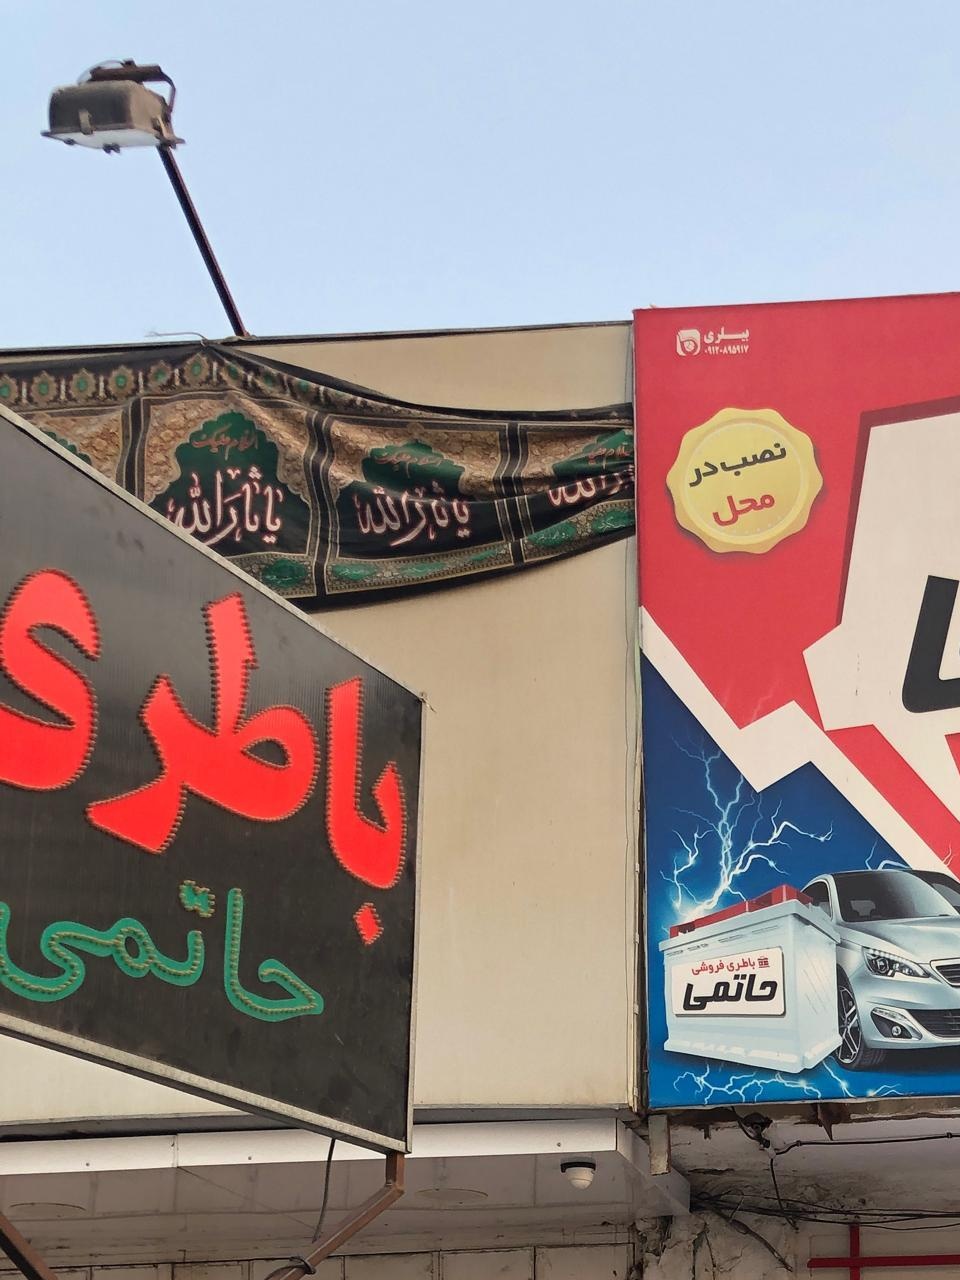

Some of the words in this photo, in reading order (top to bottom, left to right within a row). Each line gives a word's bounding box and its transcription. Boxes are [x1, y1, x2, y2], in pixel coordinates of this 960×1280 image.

[688, 461, 719, 487] در
[719, 442, 787, 477] نصب
[712, 493, 776, 527] محل
[0, 567, 408, 947] باطری
[0, 879, 325, 1023] حاتمی
[691, 959, 725, 976] فروشی
[726, 957, 756, 972] باطری
[682, 973, 778, 1011] حاتمی
